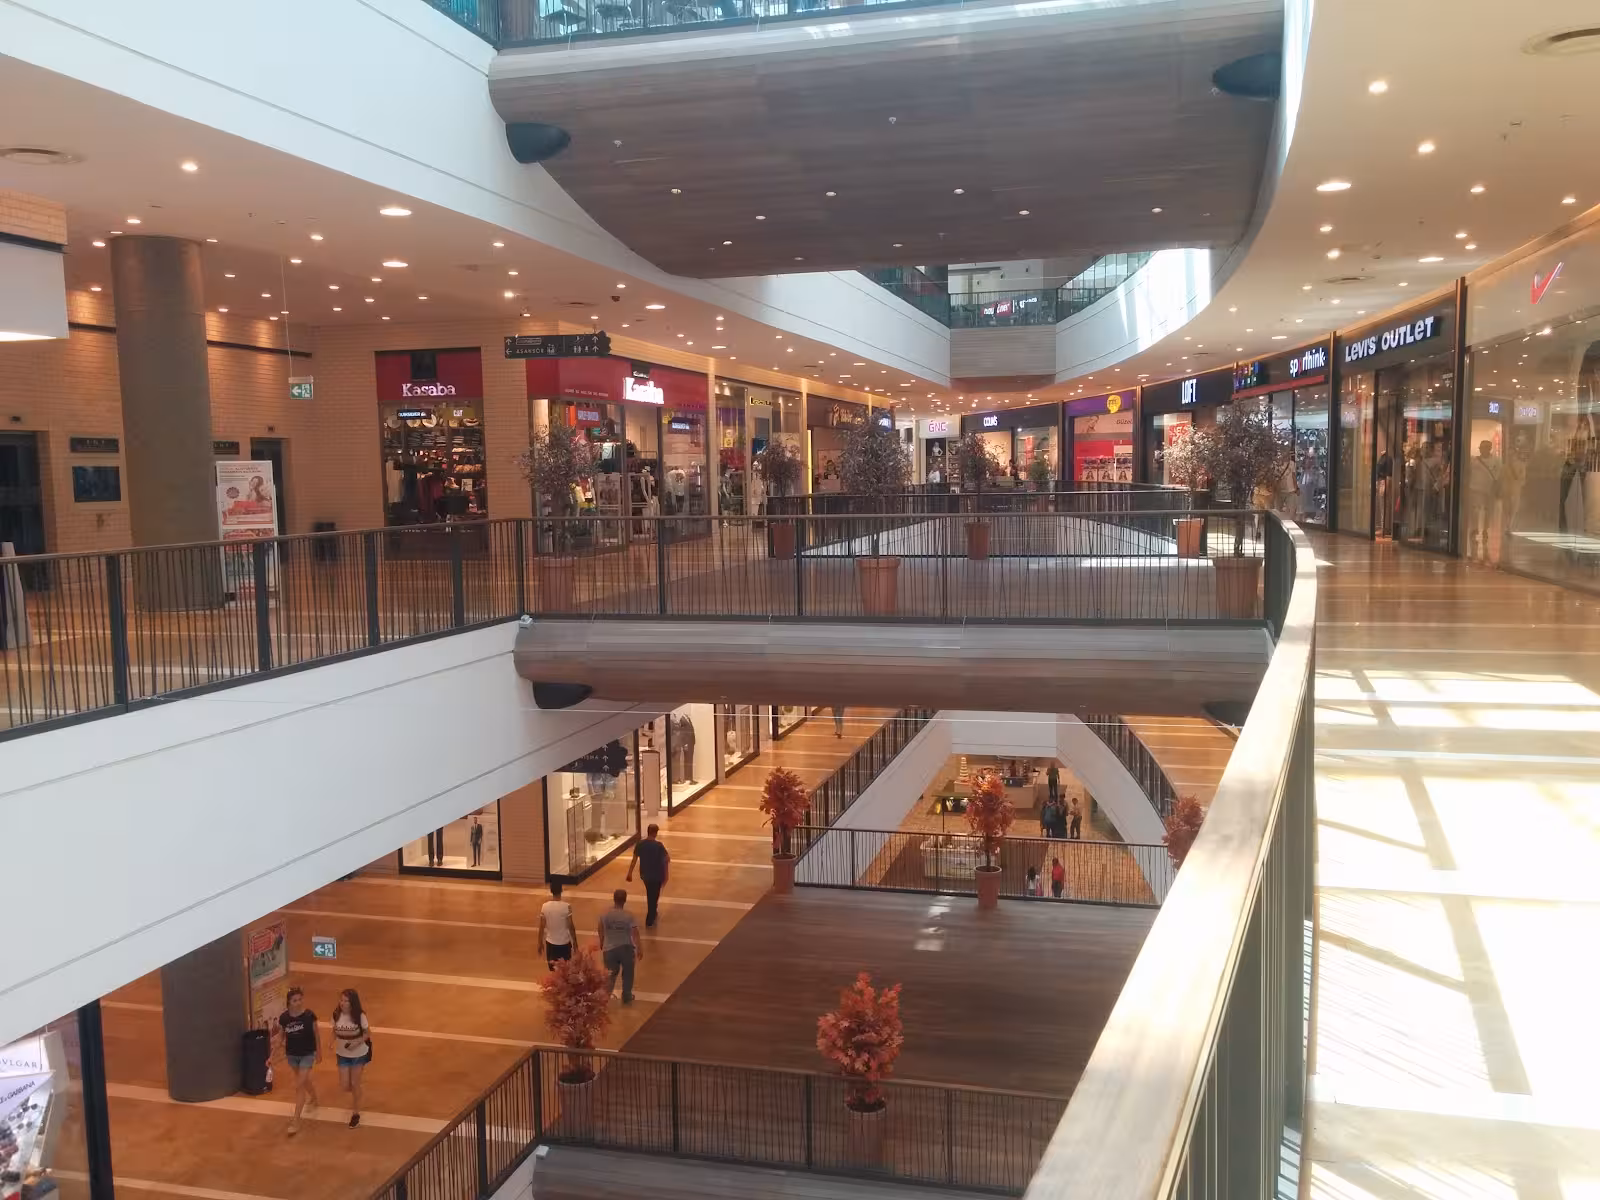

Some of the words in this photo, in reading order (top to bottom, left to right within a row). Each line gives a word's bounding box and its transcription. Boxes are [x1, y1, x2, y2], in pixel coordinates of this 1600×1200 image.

[402, 383, 456, 397] Kasaba
[1181, 378, 1197, 404] LOFT
[928, 421, 947, 432] GNC
[0, 1058, 42, 1070] VLGARI
